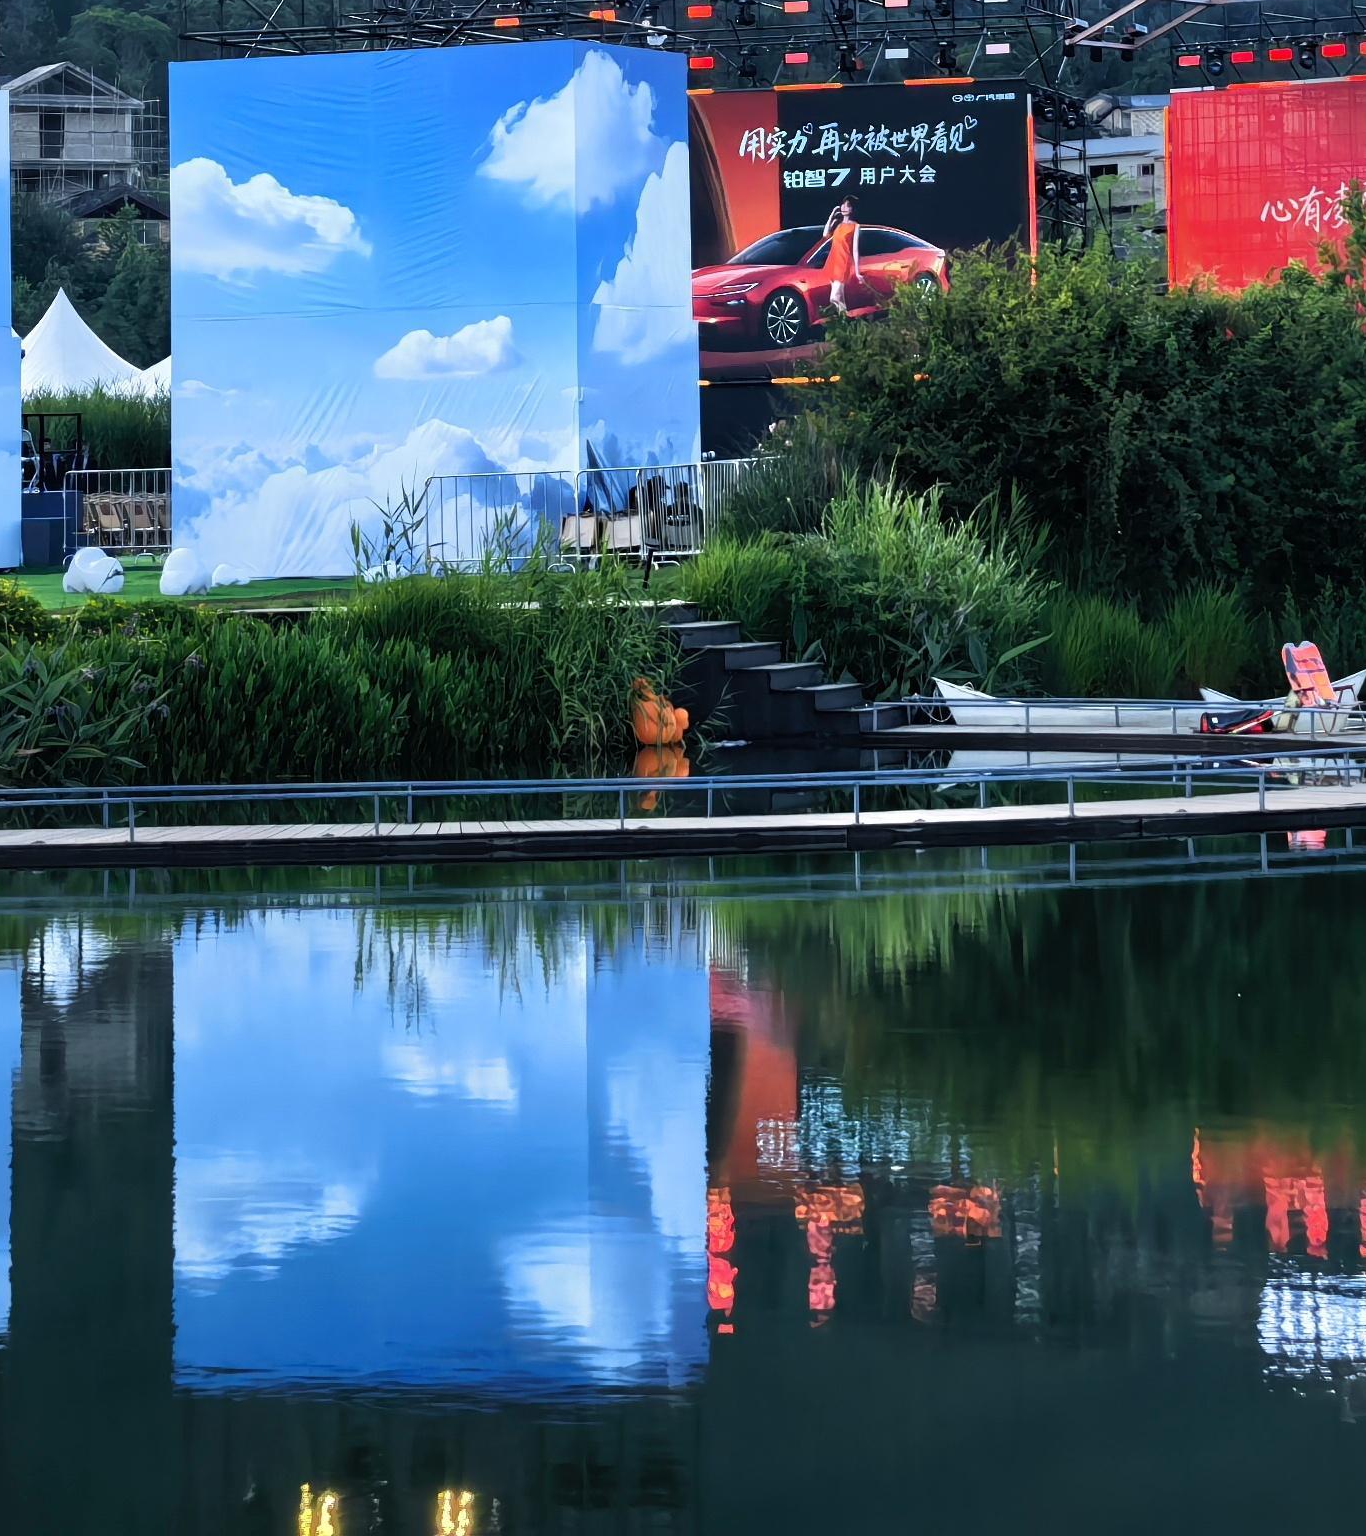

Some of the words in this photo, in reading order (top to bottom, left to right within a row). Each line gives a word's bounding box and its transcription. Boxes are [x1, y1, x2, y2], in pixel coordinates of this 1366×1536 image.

[783, 168, 851, 189] 铂智7
[859, 164, 937, 185] 用户大会
